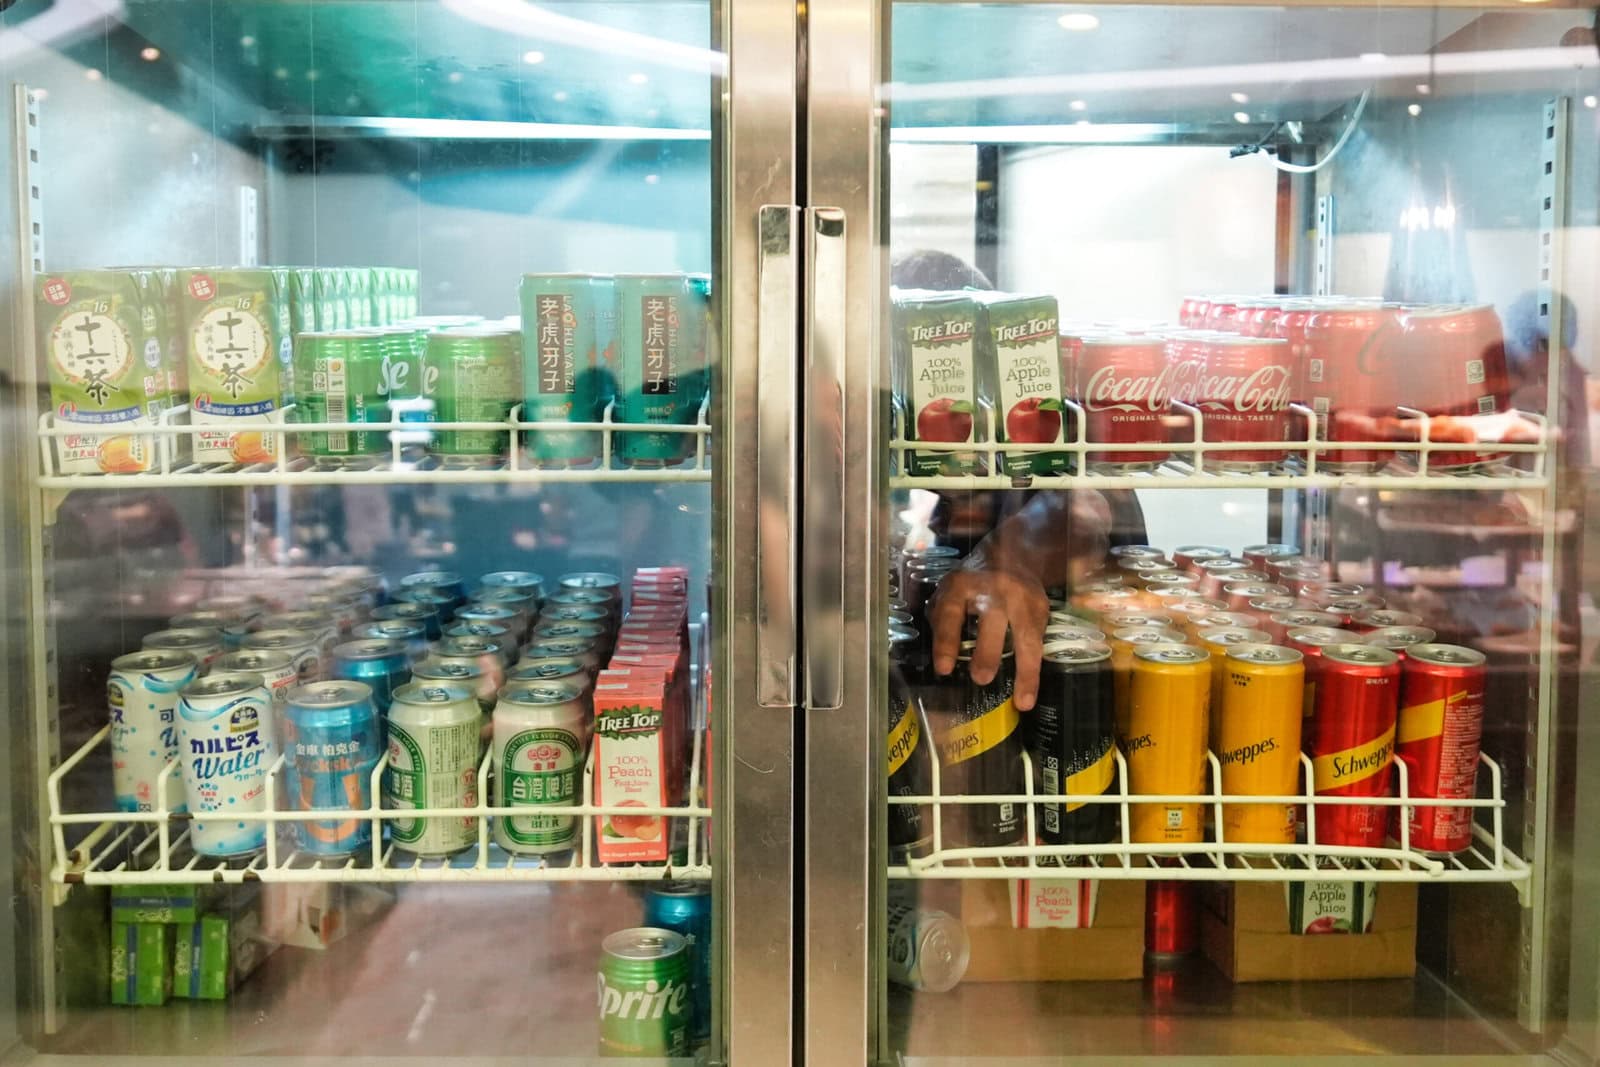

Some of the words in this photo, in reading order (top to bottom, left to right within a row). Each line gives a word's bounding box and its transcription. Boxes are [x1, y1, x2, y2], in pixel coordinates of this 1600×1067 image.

[94, 301, 108, 313] 16
[237, 298, 250, 309] 16
[912, 325, 943, 342] TREE
[943, 320, 973, 335] TOP
[996, 325, 1027, 342] TREE
[1027, 318, 1056, 334] TOP
[541, 297, 560, 391] 老虎牙子
[646, 298, 665, 392] 老虎牙子
[74, 316, 118, 406] 十六茶
[216, 311, 253, 399] 十六茶
[928, 358, 961, 368] 100%
[919, 366, 965, 382] Apple
[1006, 366, 1051, 382] Apple
[928, 383, 965, 398] Juice
[1015, 382, 1052, 398] Juice
[599, 716, 631, 732] TREE
[631, 713, 660, 728] TOP
[190, 730, 260, 754] カルピス
[192, 749, 265, 779] Water
[608, 765, 652, 779] Peach
[1308, 889, 1346, 902] Apple
[1315, 903, 1346, 915] Juice
